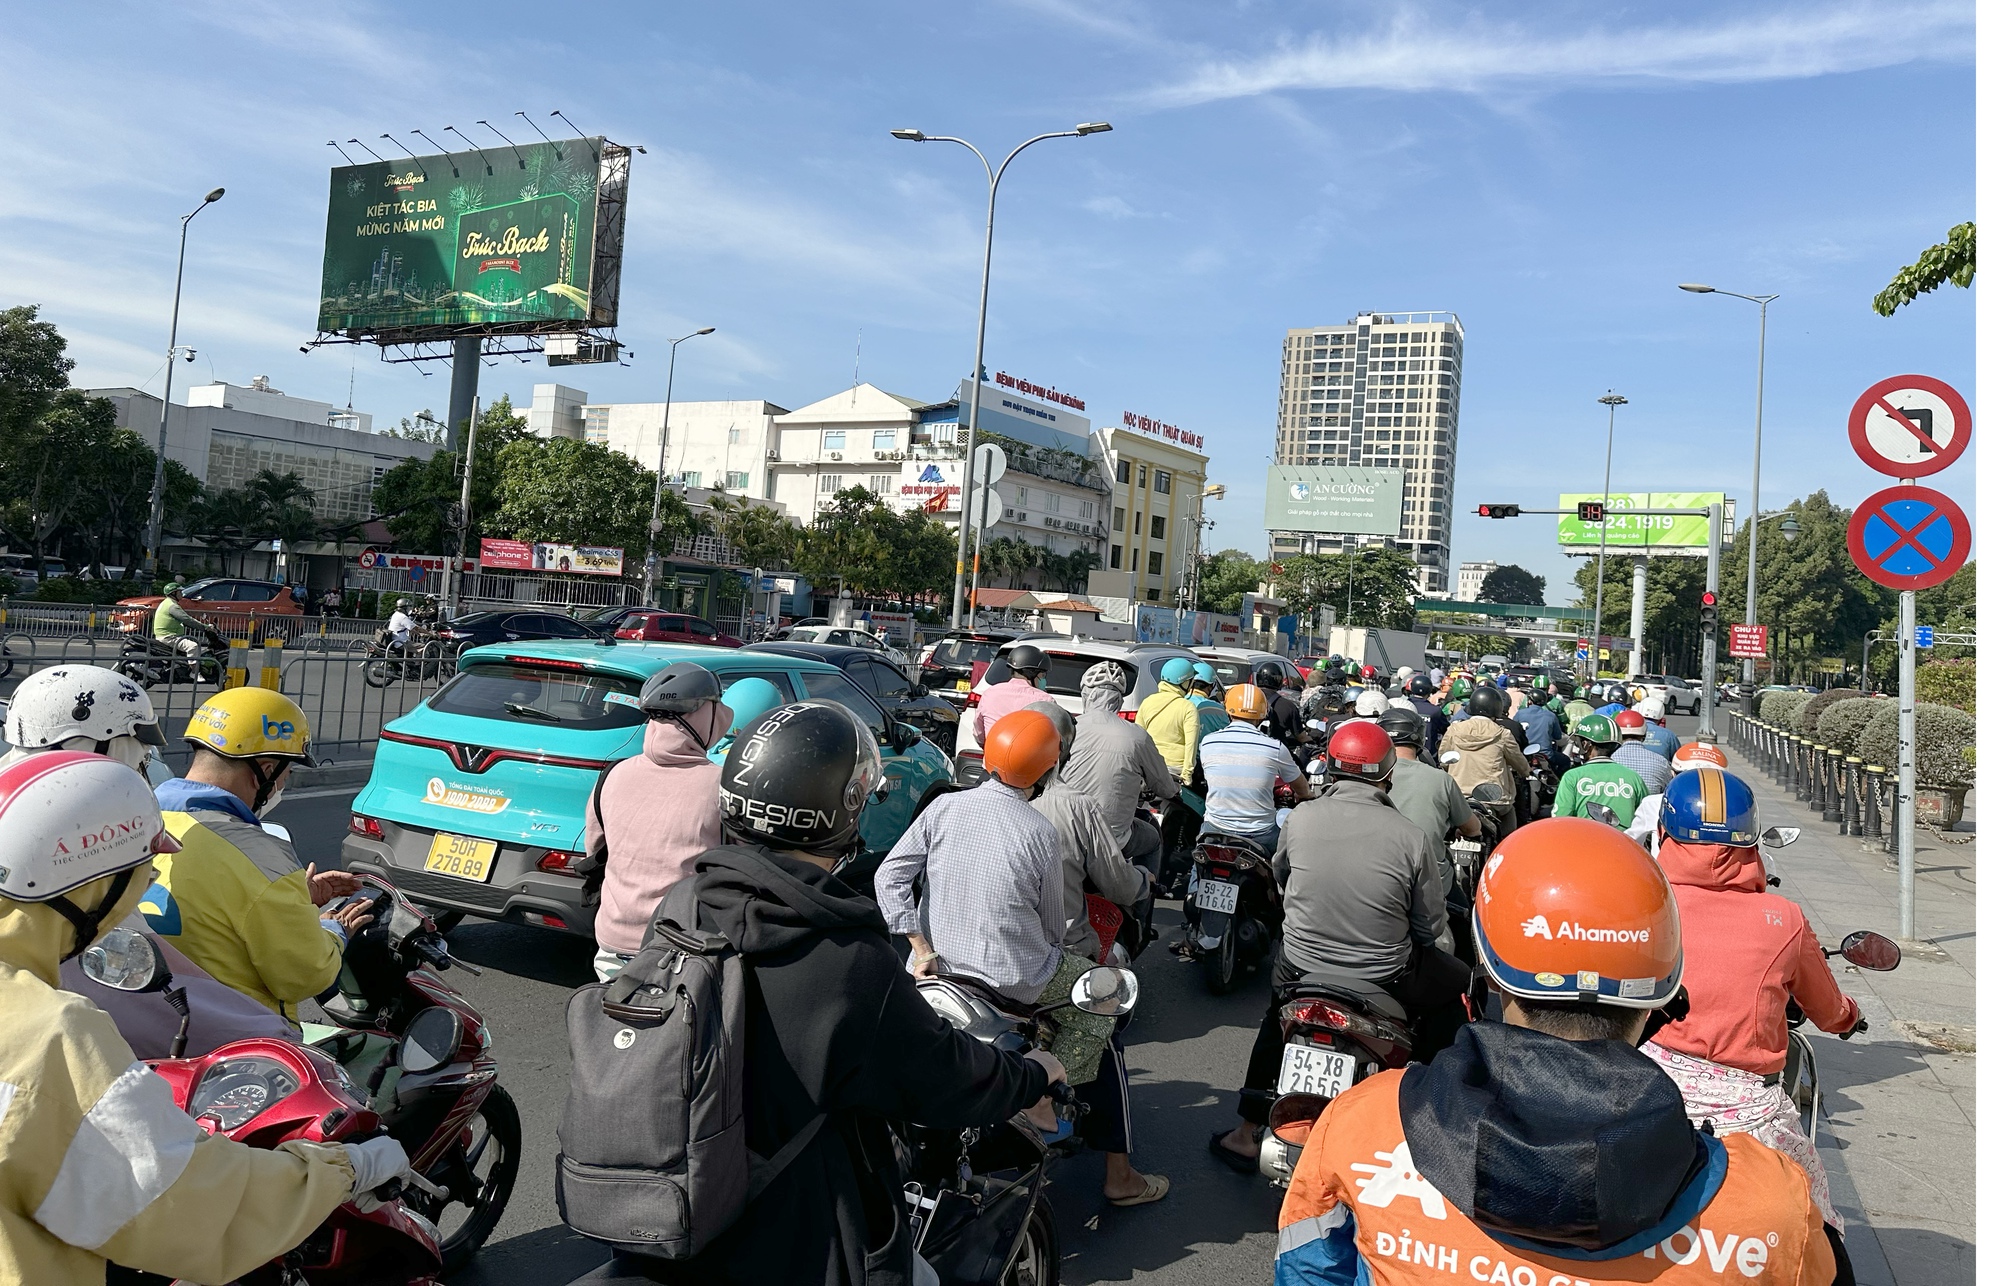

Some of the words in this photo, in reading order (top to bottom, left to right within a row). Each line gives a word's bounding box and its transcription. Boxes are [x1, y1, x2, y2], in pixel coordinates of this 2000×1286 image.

[366, 202, 391, 219] KIỆT
[393, 199, 415, 215] TÁC
[417, 199, 437, 213] BIA
[356, 221, 390, 237] MỪNG
[393, 218, 419, 234] NĂM
[421, 214, 445, 231] MỚI
[462, 231, 497, 258] Trúc
[496, 225, 550, 258] Bạch
[996, 370, 1016, 389] BỆNH
[1015, 378, 1032, 396] VIỆN
[1031, 384, 1046, 401] PHỤ
[1046, 385, 1060, 403] SẢN
[1123, 410, 1136, 431] HỌC
[1138, 415, 1152, 434] VIỆN
[1163, 424, 1180, 444] THUẬT
[1196, 435, 1204, 453] SỰ
[1313, 485, 1331, 493] AN
[1331, 482, 1375, 495] CƯỜNG
[1299, 508, 1312, 516] pháp
[1606, 532, 1626, 540] quảng
[1752, 626, 1758, 634] Ý
[261, 714, 295, 740] be
[733, 703, 810, 787] DESIGN
[1692, 750, 1717, 760] KALINA
[449, 781, 463, 789] TỔNG
[463, 784, 473, 792] ĐÀI
[474, 785, 488, 794] TOÀN
[488, 787, 504, 796] QUỐC
[1576, 777, 1634, 799] Grab
[443, 791, 470, 807] 1900
[467, 795, 497, 811] 2088
[730, 793, 837, 829] DESIGN
[51, 837, 70, 857] Á
[81, 815, 143, 850] ĐÔNG
[53, 855, 75, 866] TIỆC
[102, 842, 113, 852] VÀ
[115, 837, 128, 849] HỘI
[449, 837, 478, 858] 50H
[432, 853, 483, 877] 278.89
[1204, 882, 1233, 898] 59-Z2
[1199, 894, 1234, 911] 116.46
[1557, 921, 1649, 943] Ahamove
[1293, 1049, 1344, 1077] 54-X8
[1289, 1072, 1341, 1099] 2656
[1375, 1228, 1459, 1274] ĐỈNH
[1469, 1256, 1537, 1286] CAO
